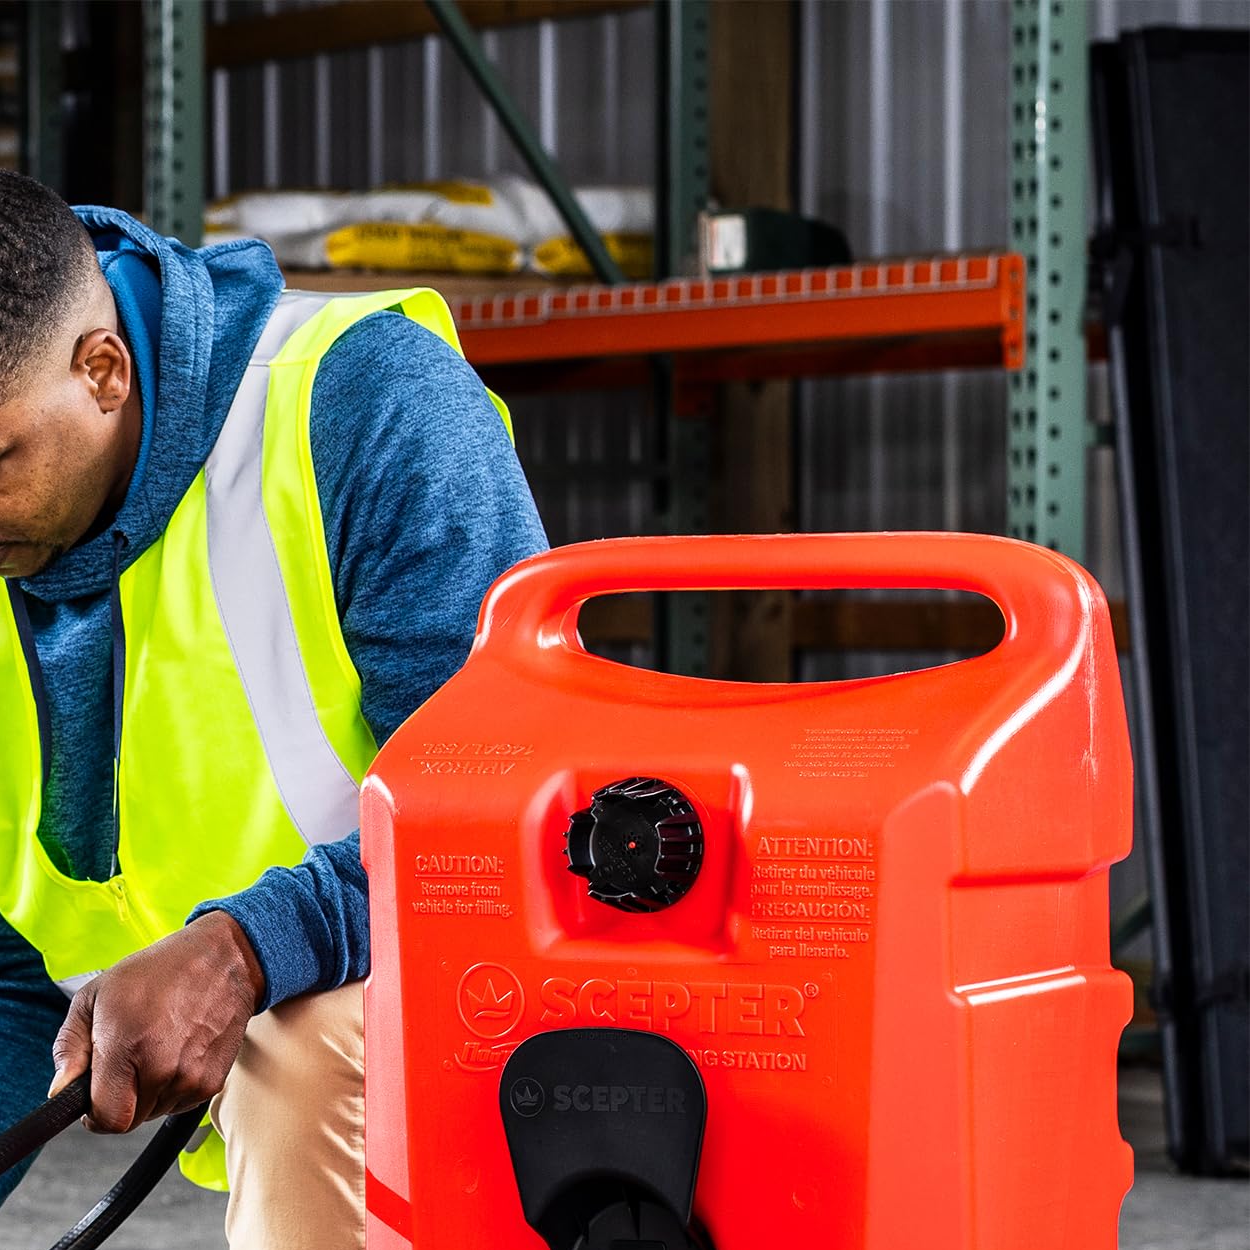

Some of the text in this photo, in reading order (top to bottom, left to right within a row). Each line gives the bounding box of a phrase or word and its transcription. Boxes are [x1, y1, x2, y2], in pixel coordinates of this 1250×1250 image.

[420, 761, 515, 775] APPROX.
[757, 836, 873, 856] ATTENTION:
[415, 855, 504, 873] CAUTION:
[752, 864, 797, 879] Retirer
[799, 865, 817, 879] du
[421, 881, 500, 897] Remove from
[750, 881, 874, 900] pour le remplissage.
[412, 899, 513, 918] vehicle for filling.
[751, 900, 870, 919] PRECAUCIÓN:
[751, 926, 792, 939] Retirar
[795, 927, 814, 940] del
[769, 943, 849, 959] para llenarlo.
[721, 1052, 807, 1072] STATION
[553, 1084, 686, 1114] SCEPTER
